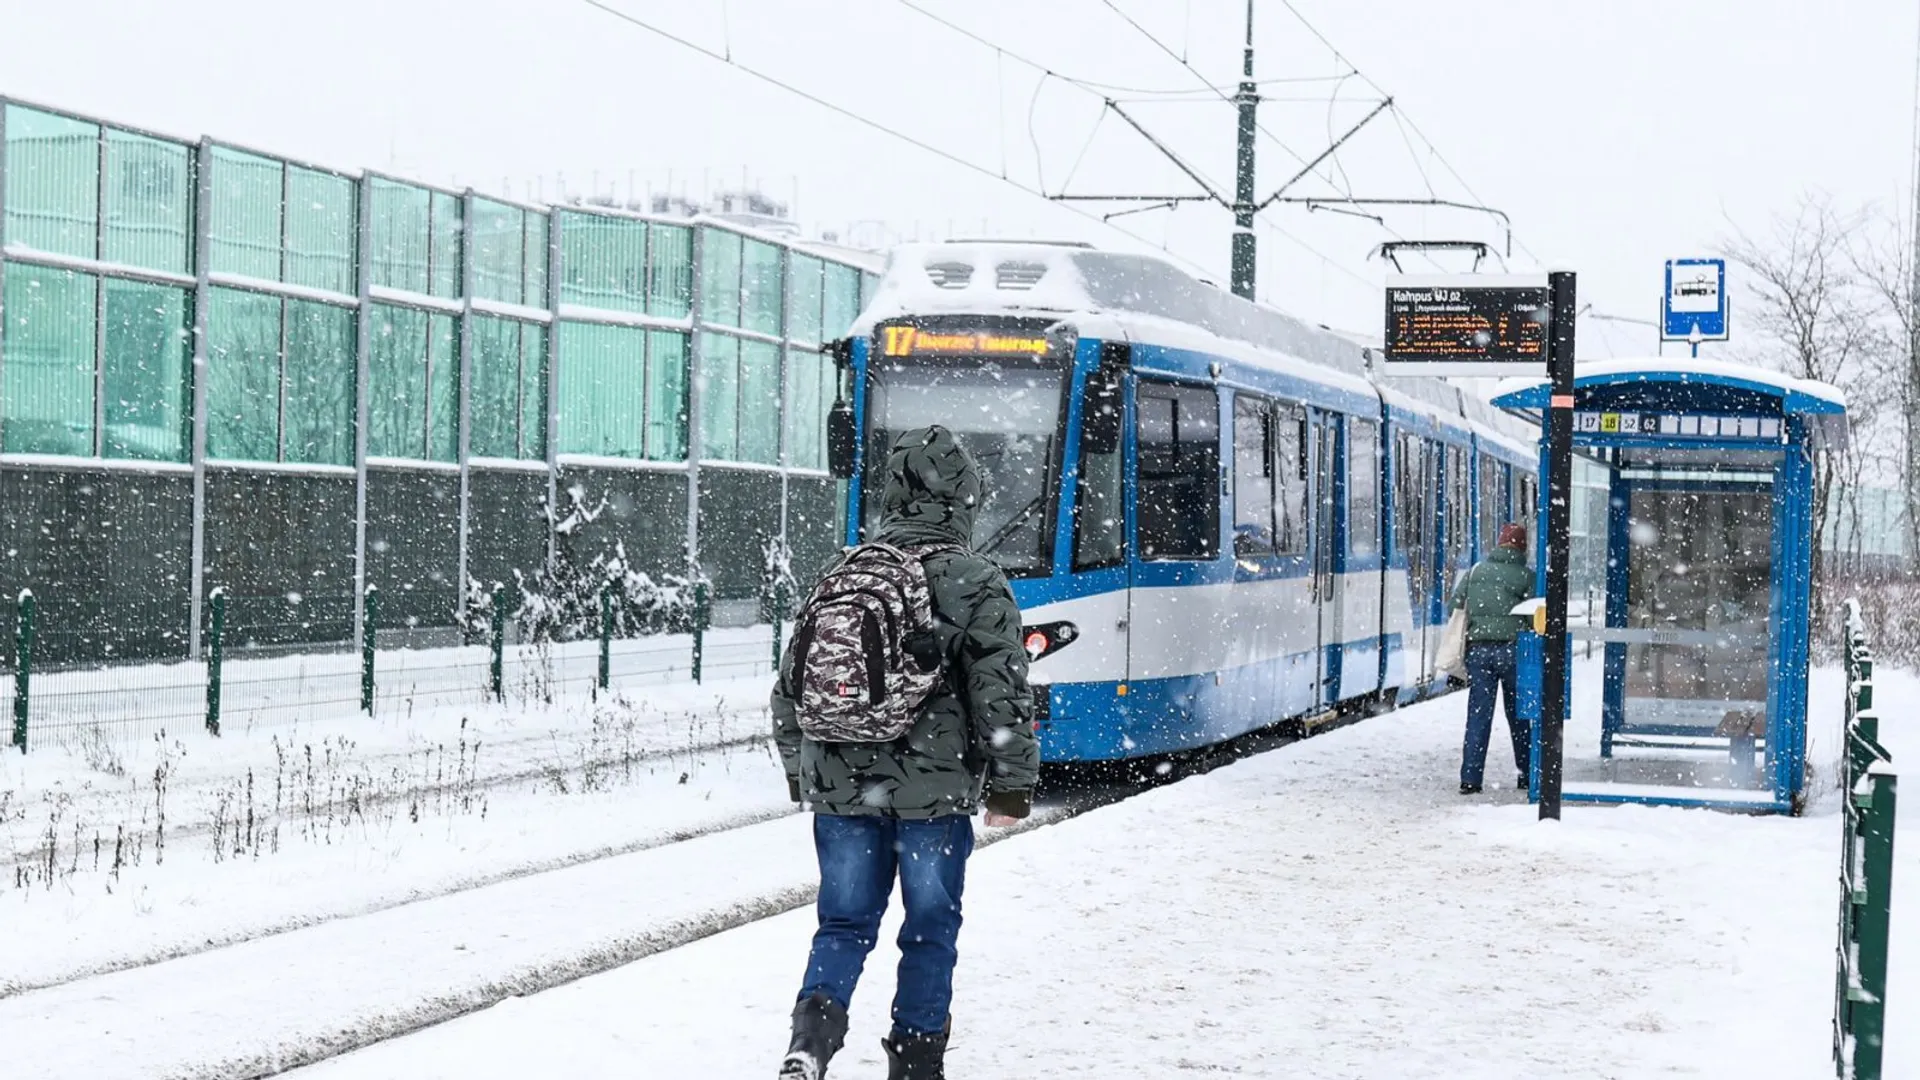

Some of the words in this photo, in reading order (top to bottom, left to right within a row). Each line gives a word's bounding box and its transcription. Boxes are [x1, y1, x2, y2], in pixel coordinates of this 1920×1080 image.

[1393, 290, 1432, 303] Kampus
[1434, 290, 1448, 302] UJ
[885, 327, 915, 356] 17
[1585, 417, 1596, 429] 17
[1605, 417, 1616, 429] 18
[1624, 418, 1636, 430] 52
[1643, 418, 1656, 431] 62
